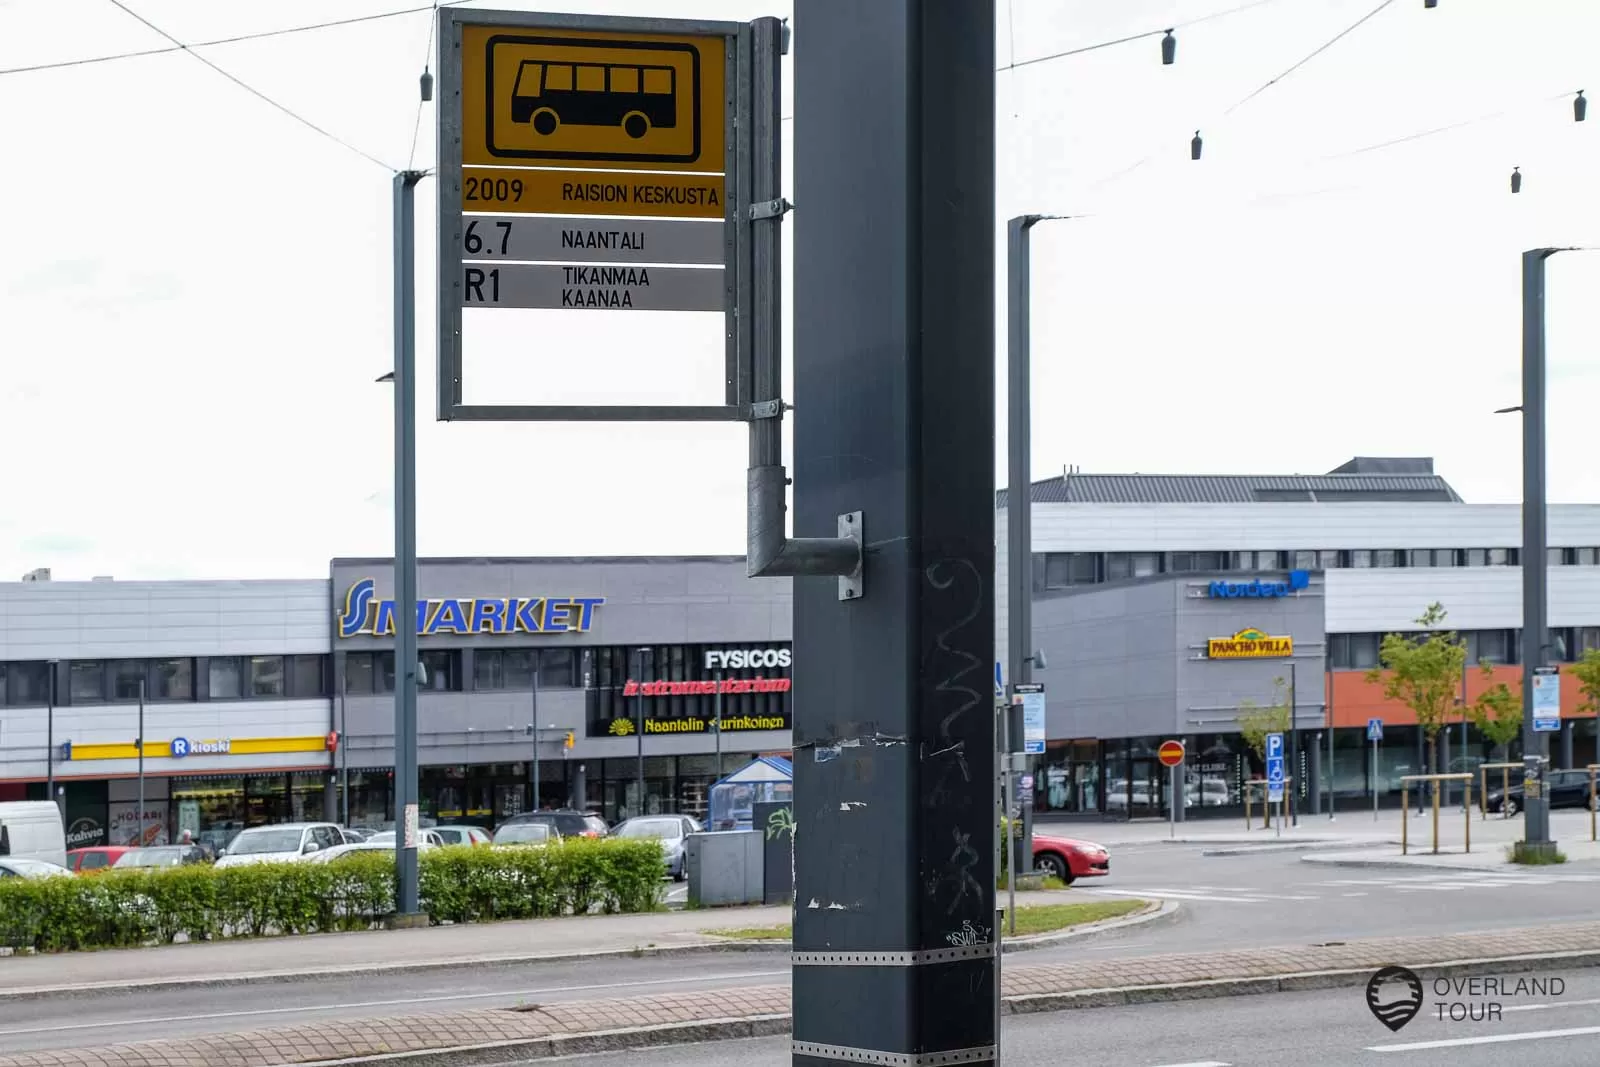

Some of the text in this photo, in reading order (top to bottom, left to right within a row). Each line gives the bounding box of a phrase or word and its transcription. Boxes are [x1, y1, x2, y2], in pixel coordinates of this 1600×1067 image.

[466, 177, 719, 206] 2009 RAISION KESKUSTA
[464, 220, 645, 255] 6.7 NAANTALI
[464, 266, 650, 302] R1 TIKANMAA
[562, 289, 633, 307] KAANAA
[1209, 578, 1288, 599] Nordea
[1211, 641, 1290, 652] PANCHO VILLA
[705, 649, 792, 669] FYSICOS
[645, 717, 704, 733] Naantalin
[190, 739, 231, 753] kioski
[1269, 736, 1280, 756] P
